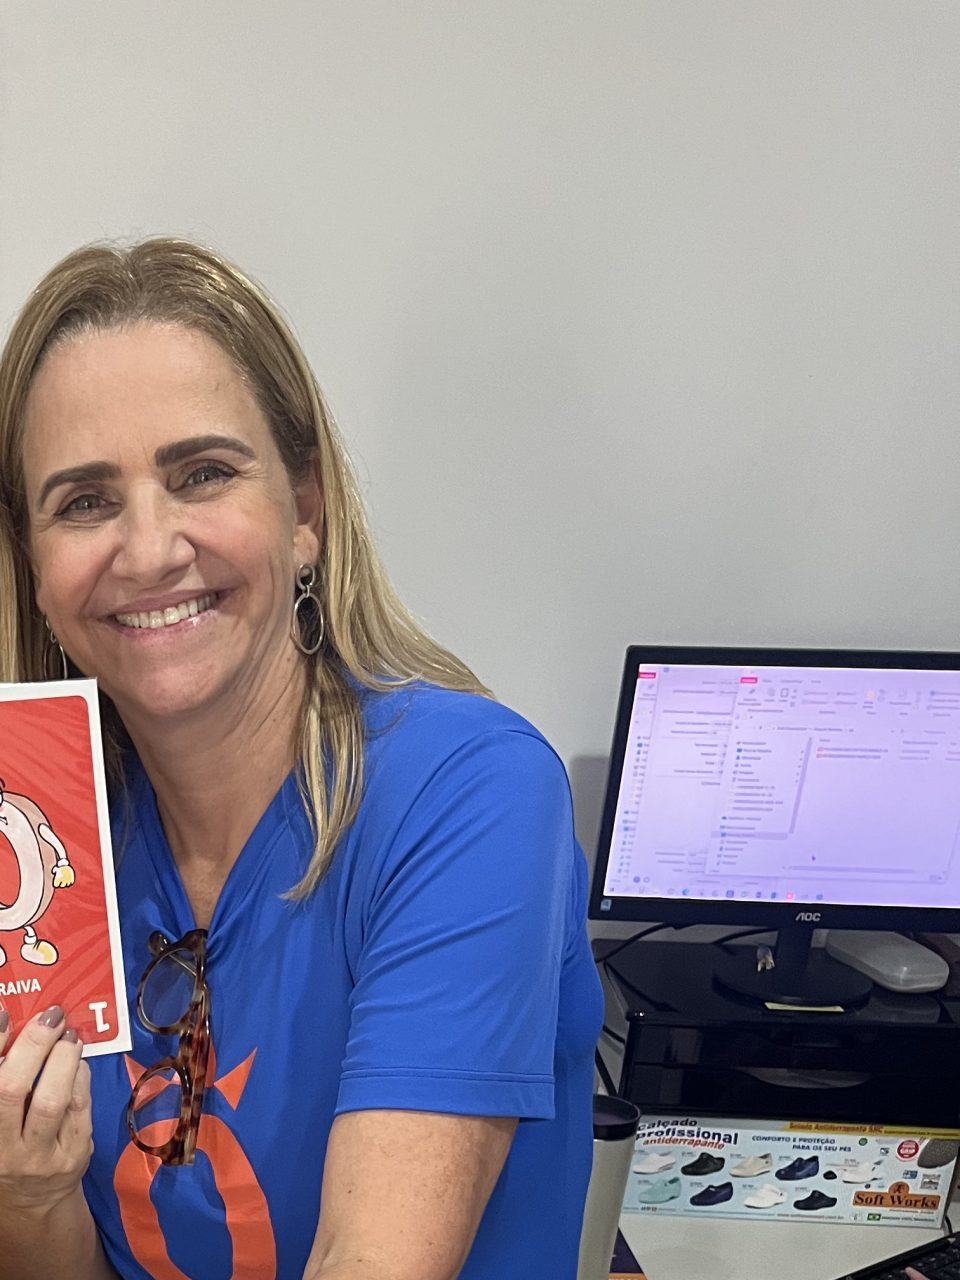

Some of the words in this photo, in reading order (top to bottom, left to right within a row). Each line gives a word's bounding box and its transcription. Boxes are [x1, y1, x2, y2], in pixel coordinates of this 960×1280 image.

[795, 912, 822, 922] AOC
[88, 1000, 111, 1033] 1
[638, 1118, 698, 1131] calçado
[636, 1128, 738, 1146] profissional
[642, 1136, 725, 1150] antiderrapante
[752, 1135, 790, 1144] CONFORTO
[798, 1136, 836, 1145] PROTEÇÃO
[854, 1193, 884, 1206] Soft
[890, 1194, 937, 1208] Works
